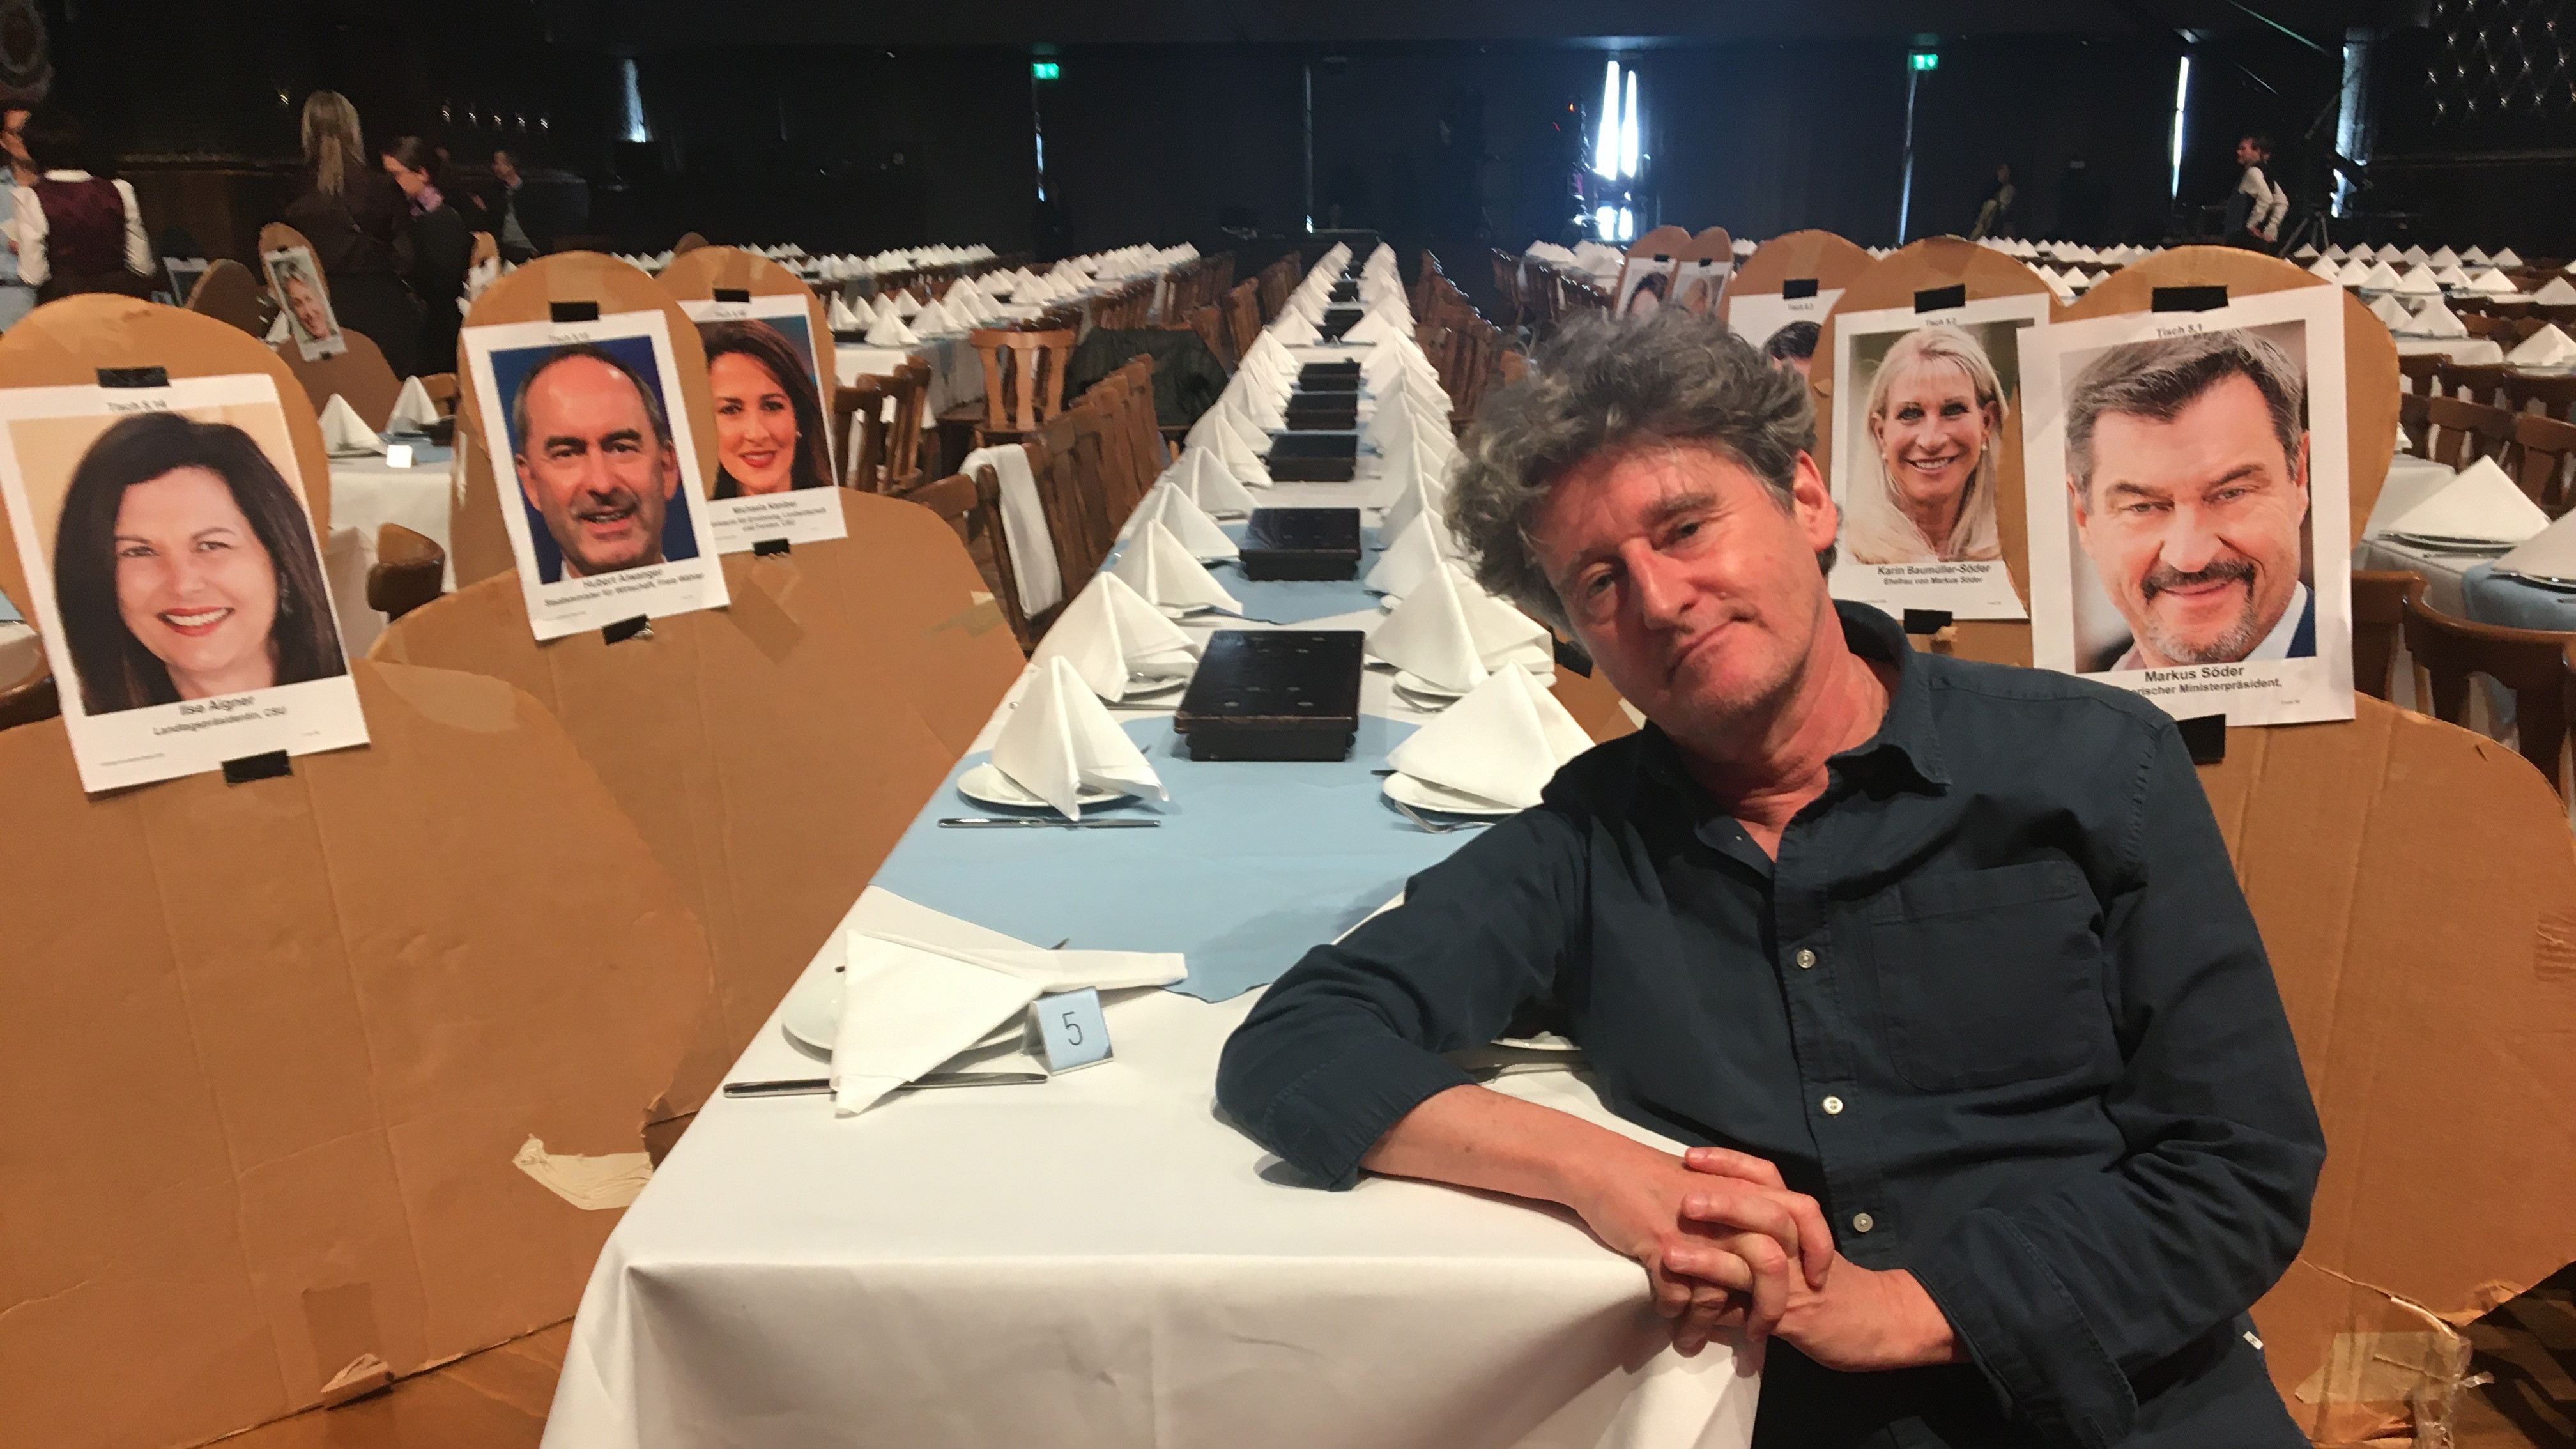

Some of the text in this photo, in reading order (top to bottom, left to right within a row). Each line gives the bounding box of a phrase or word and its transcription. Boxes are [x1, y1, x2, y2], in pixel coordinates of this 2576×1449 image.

[2156, 325, 2186, 338] Tisch
[1877, 563, 1991, 576] Karin Baumüller-Söder
[2144, 665, 2245, 682] Markus Söder
[208, 696, 256, 712] Aigner
[1062, 1011, 1084, 1046] 5
